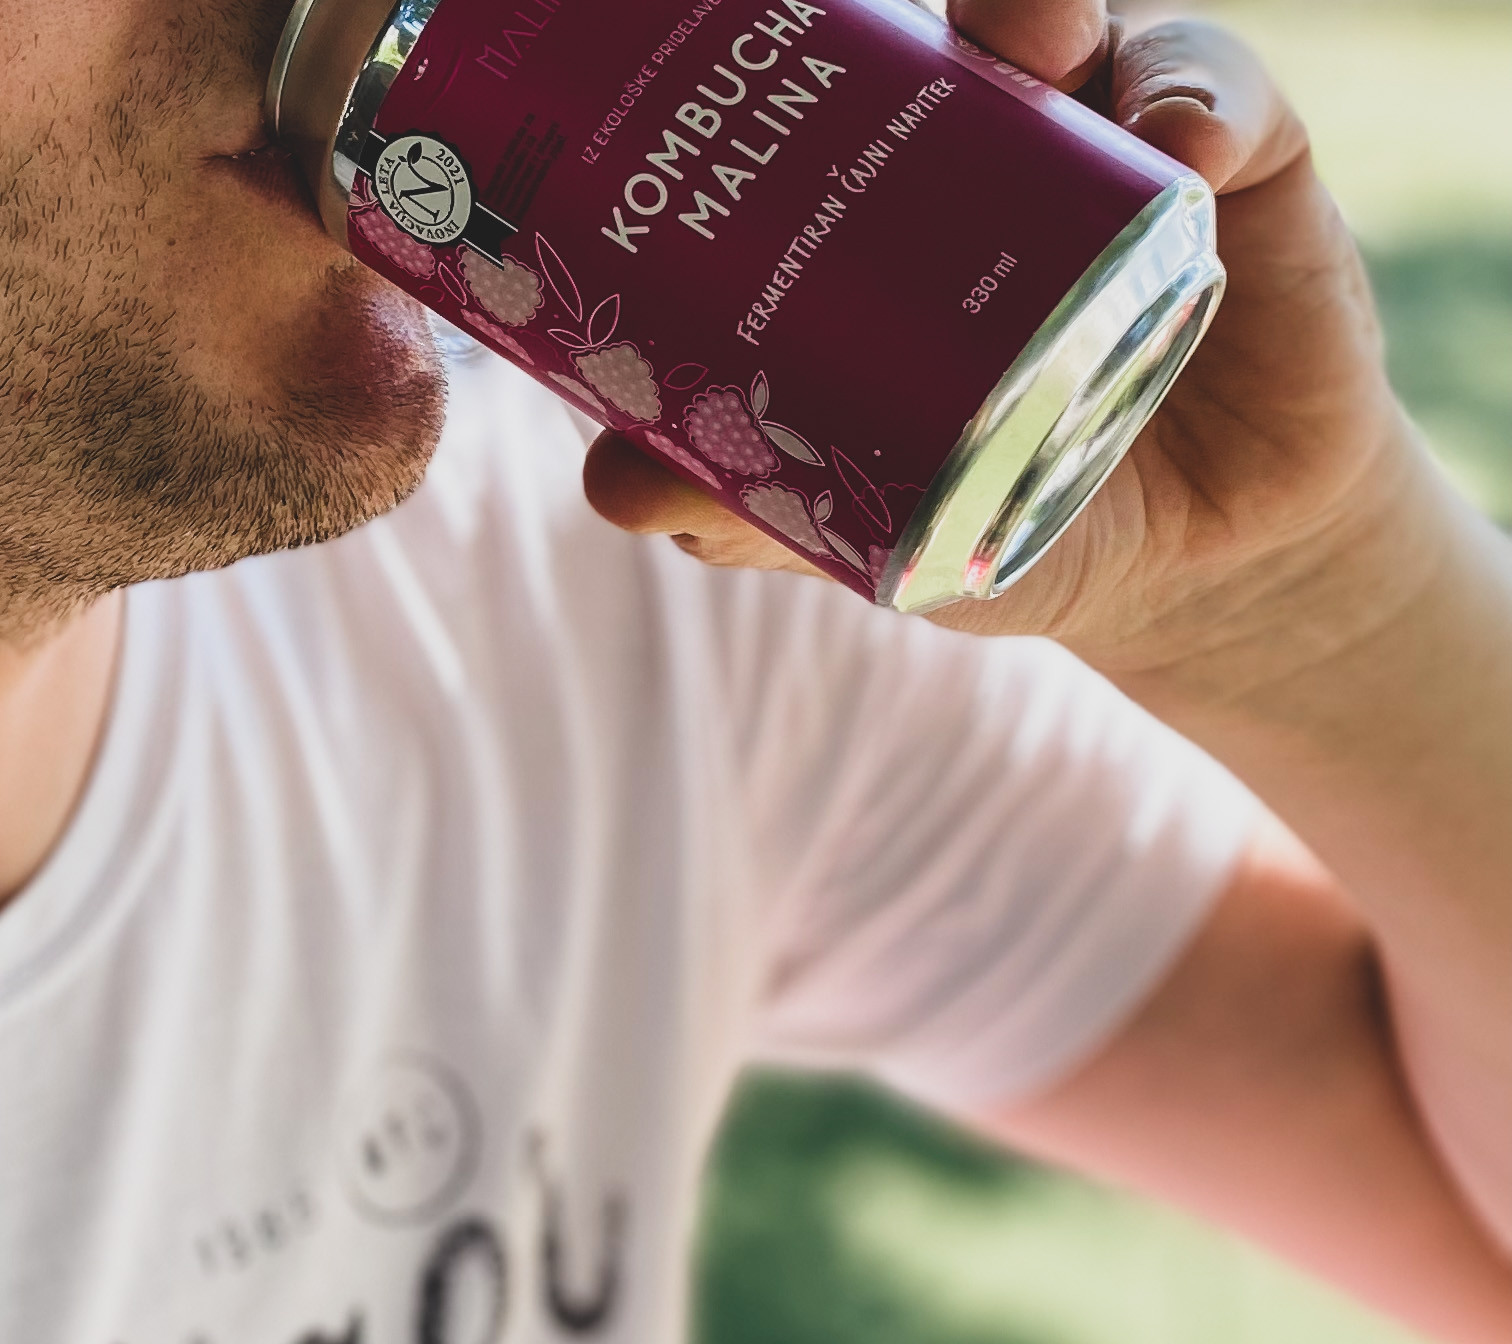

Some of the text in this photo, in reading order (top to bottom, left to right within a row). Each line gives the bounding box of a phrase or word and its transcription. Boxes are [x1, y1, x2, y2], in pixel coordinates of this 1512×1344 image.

[580, 145, 601, 165] IZ
[592, 63, 658, 146] EKOLOŠKE
[677, 55, 847, 240] MALINA
[378, 148, 466, 240] INOVACIJA LETA 2021
[736, 77, 957, 346] FERMENTIRAN ČAJNI NAPITEK
[961, 251, 1019, 314] 330 ml
